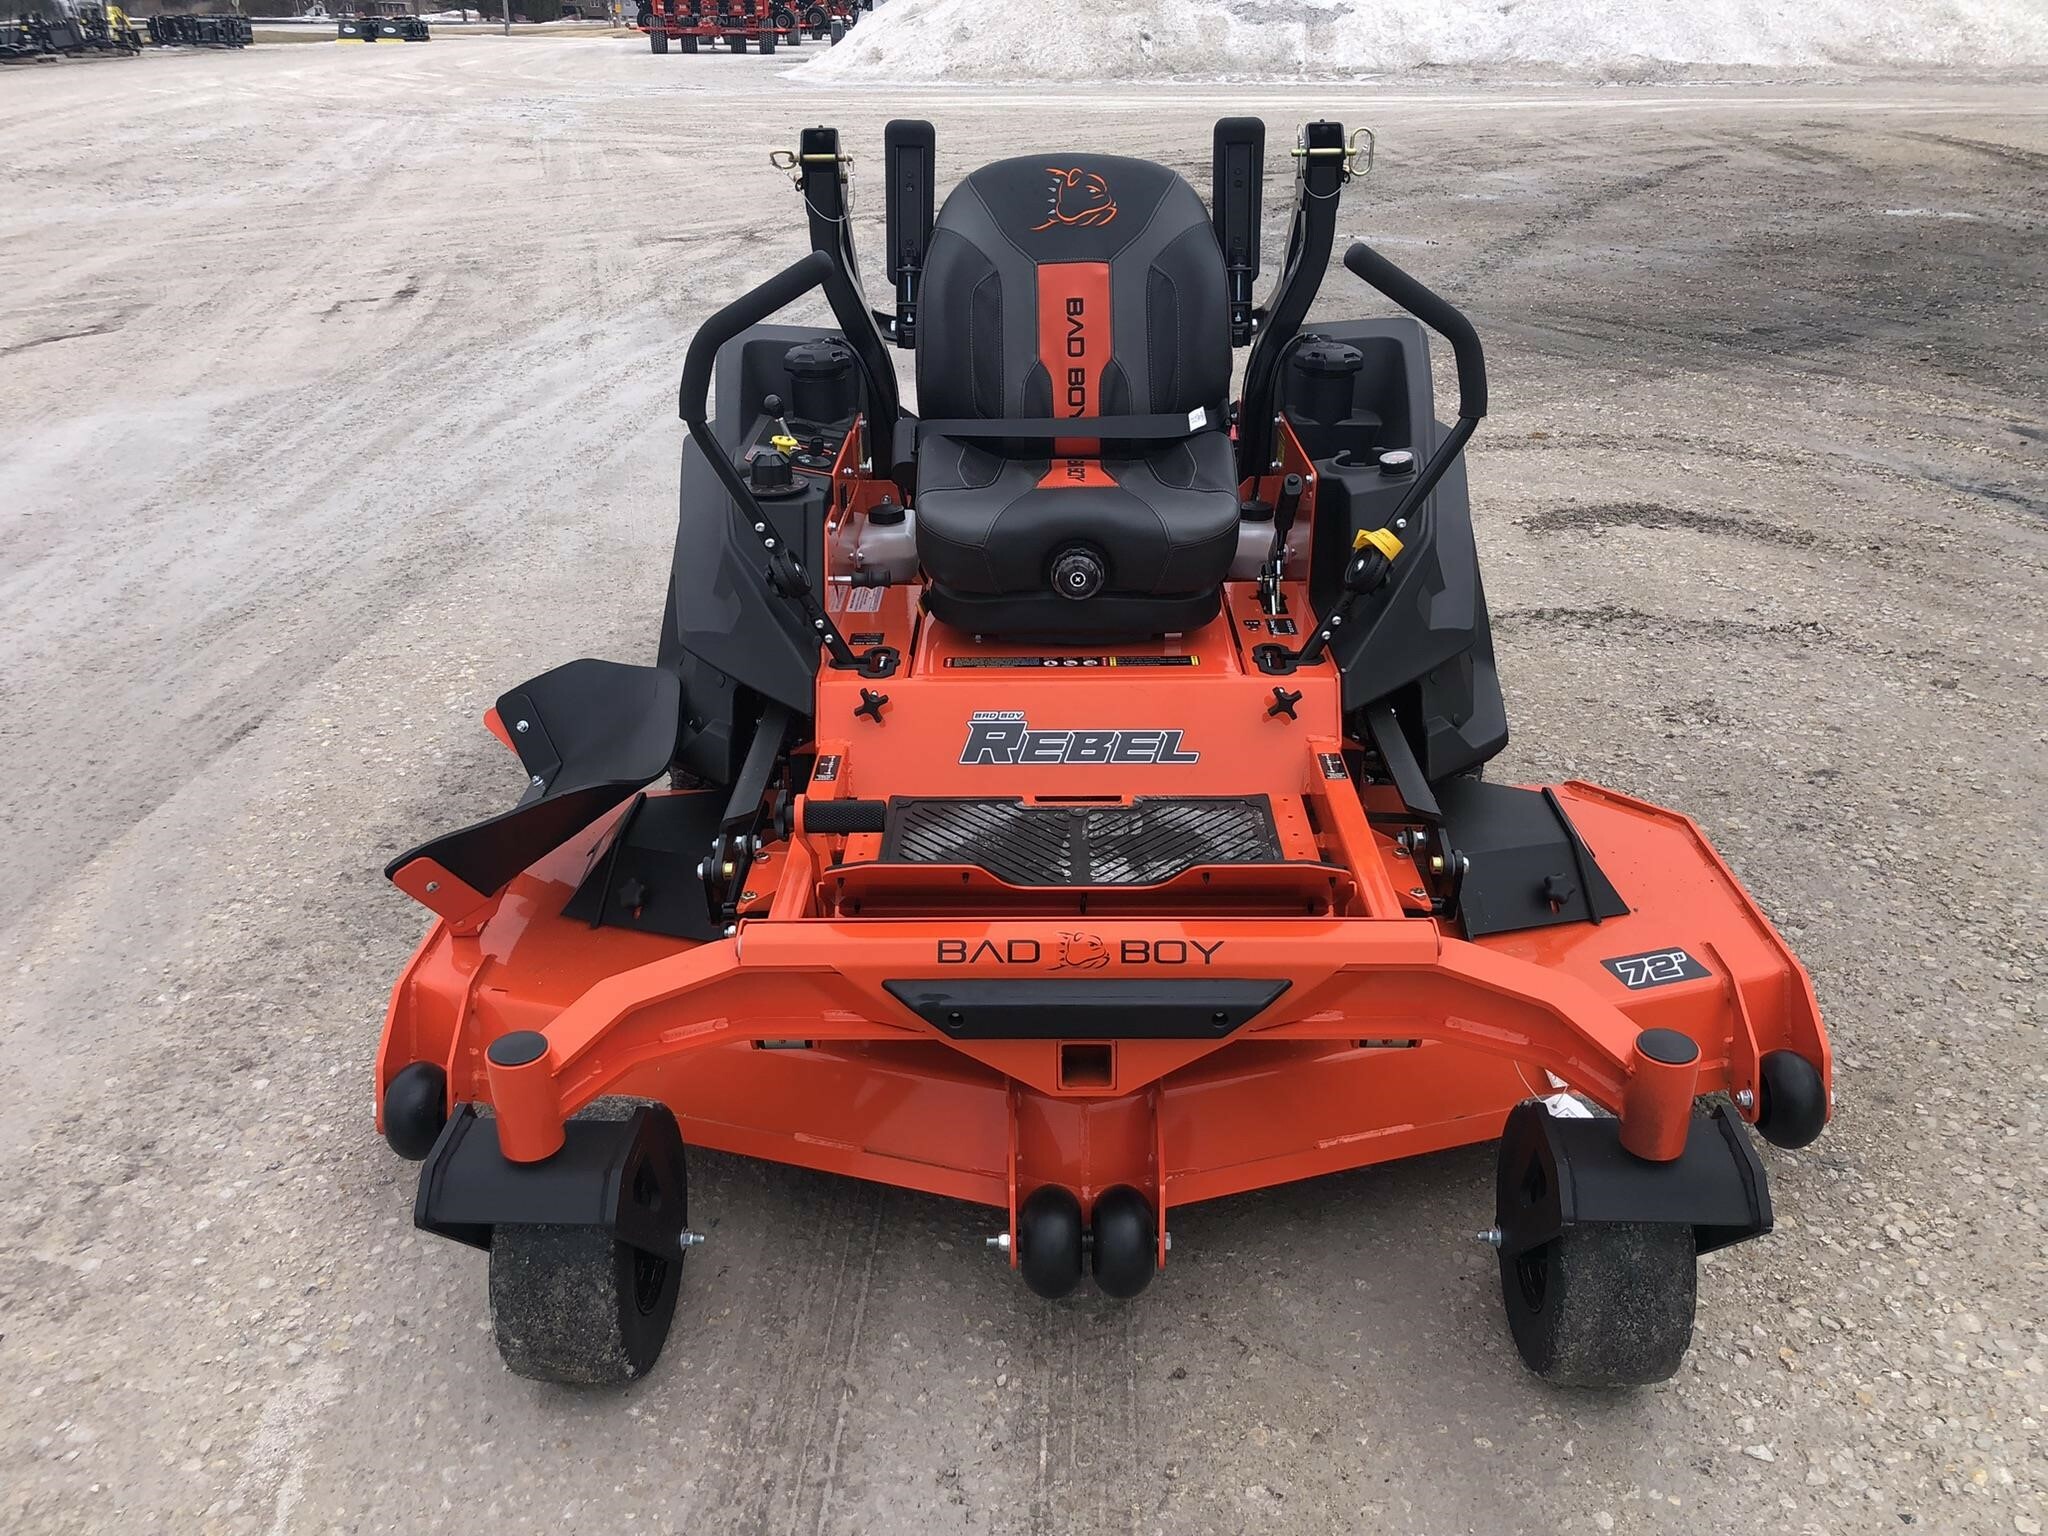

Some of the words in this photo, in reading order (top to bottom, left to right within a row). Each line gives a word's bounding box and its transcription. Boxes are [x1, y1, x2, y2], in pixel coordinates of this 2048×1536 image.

[1066, 297, 1085, 357] BAD
[973, 712, 997, 720] BAD
[999, 712, 1024, 720] BOY
[959, 721, 1200, 764] REBEL
[937, 939, 1041, 964] BAD
[1120, 939, 1225, 964] BOY
[1615, 951, 1687, 986] 72"
